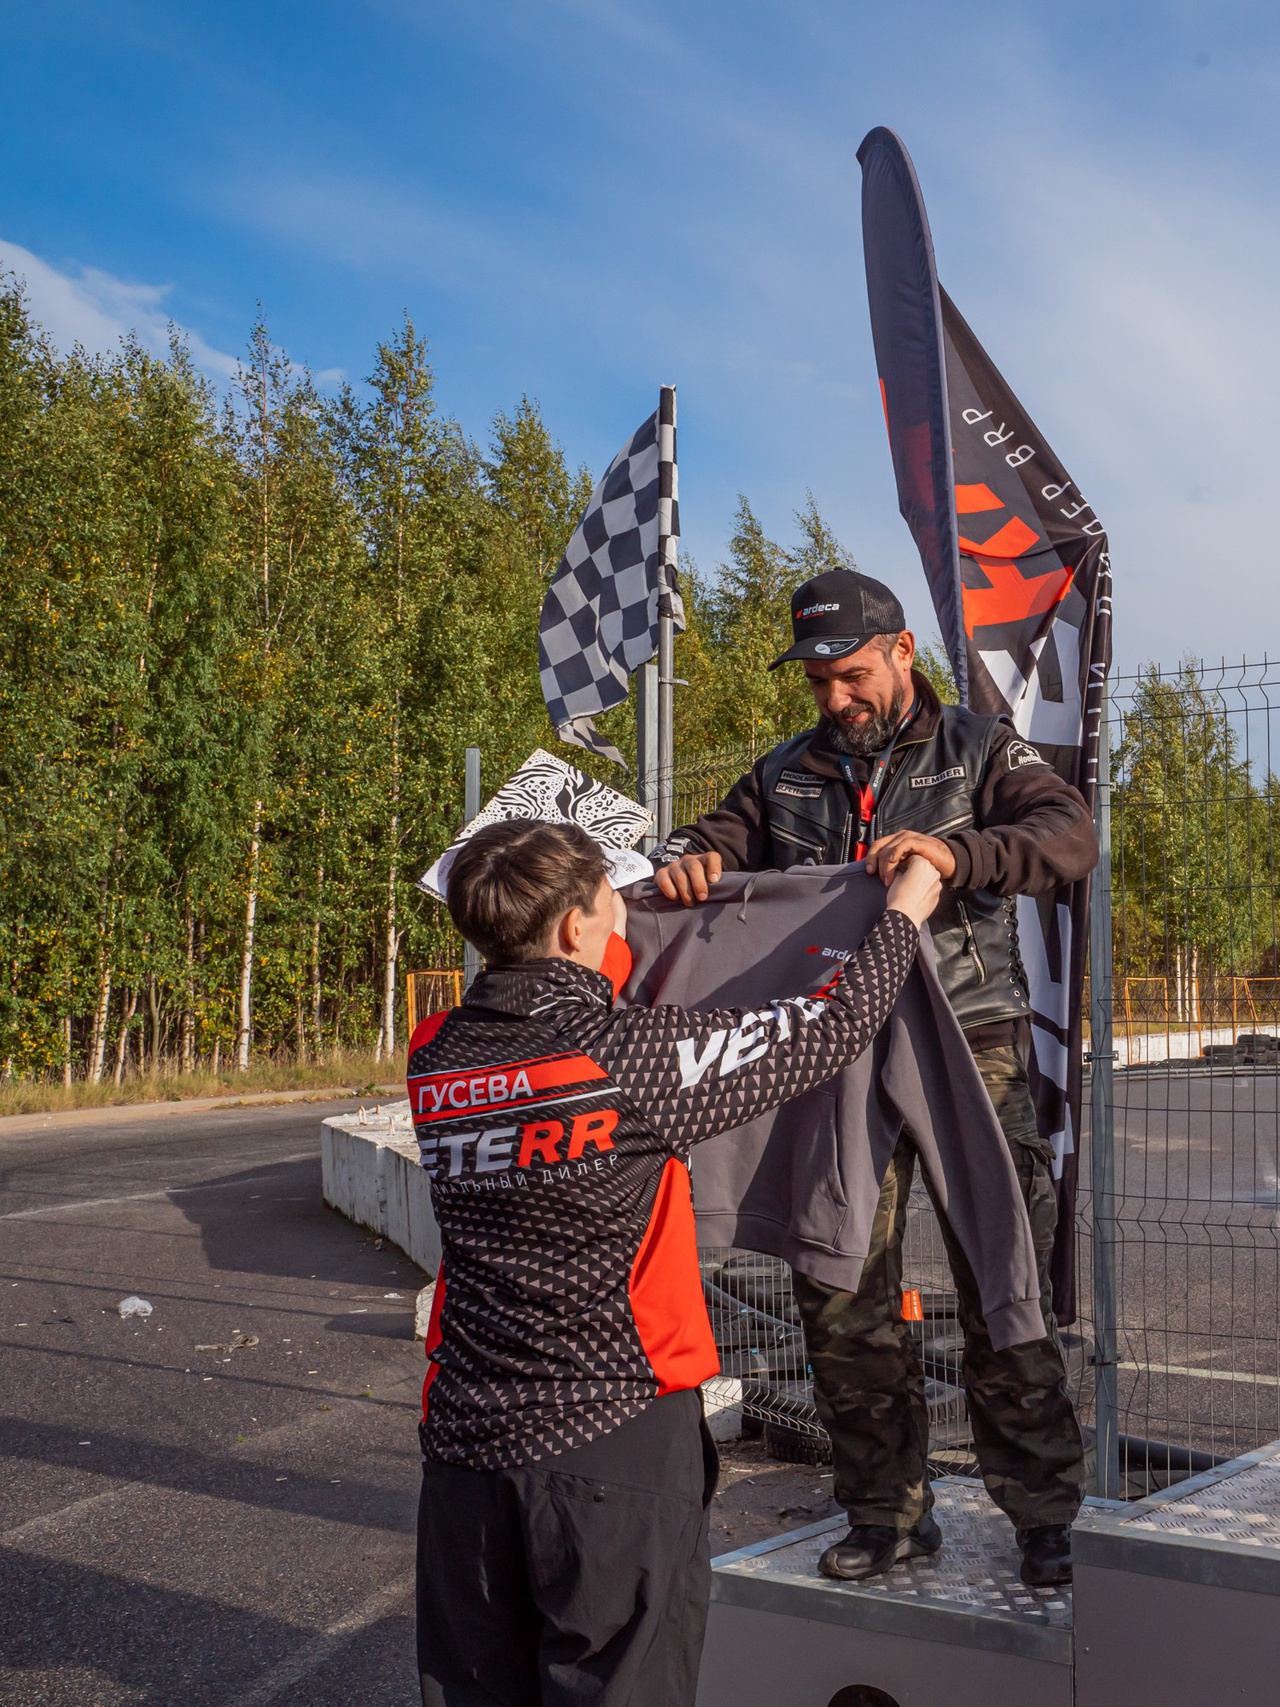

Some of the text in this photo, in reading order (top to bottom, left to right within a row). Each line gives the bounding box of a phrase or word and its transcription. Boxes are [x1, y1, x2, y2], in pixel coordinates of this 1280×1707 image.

[961, 407, 1036, 468] BRP
[802, 602, 841, 616] ardeca
[914, 768, 962, 786] MEMBER
[418, 1070, 534, 1114] ГУСЕВА
[542, 1154, 618, 1186] ДИЛЕР
